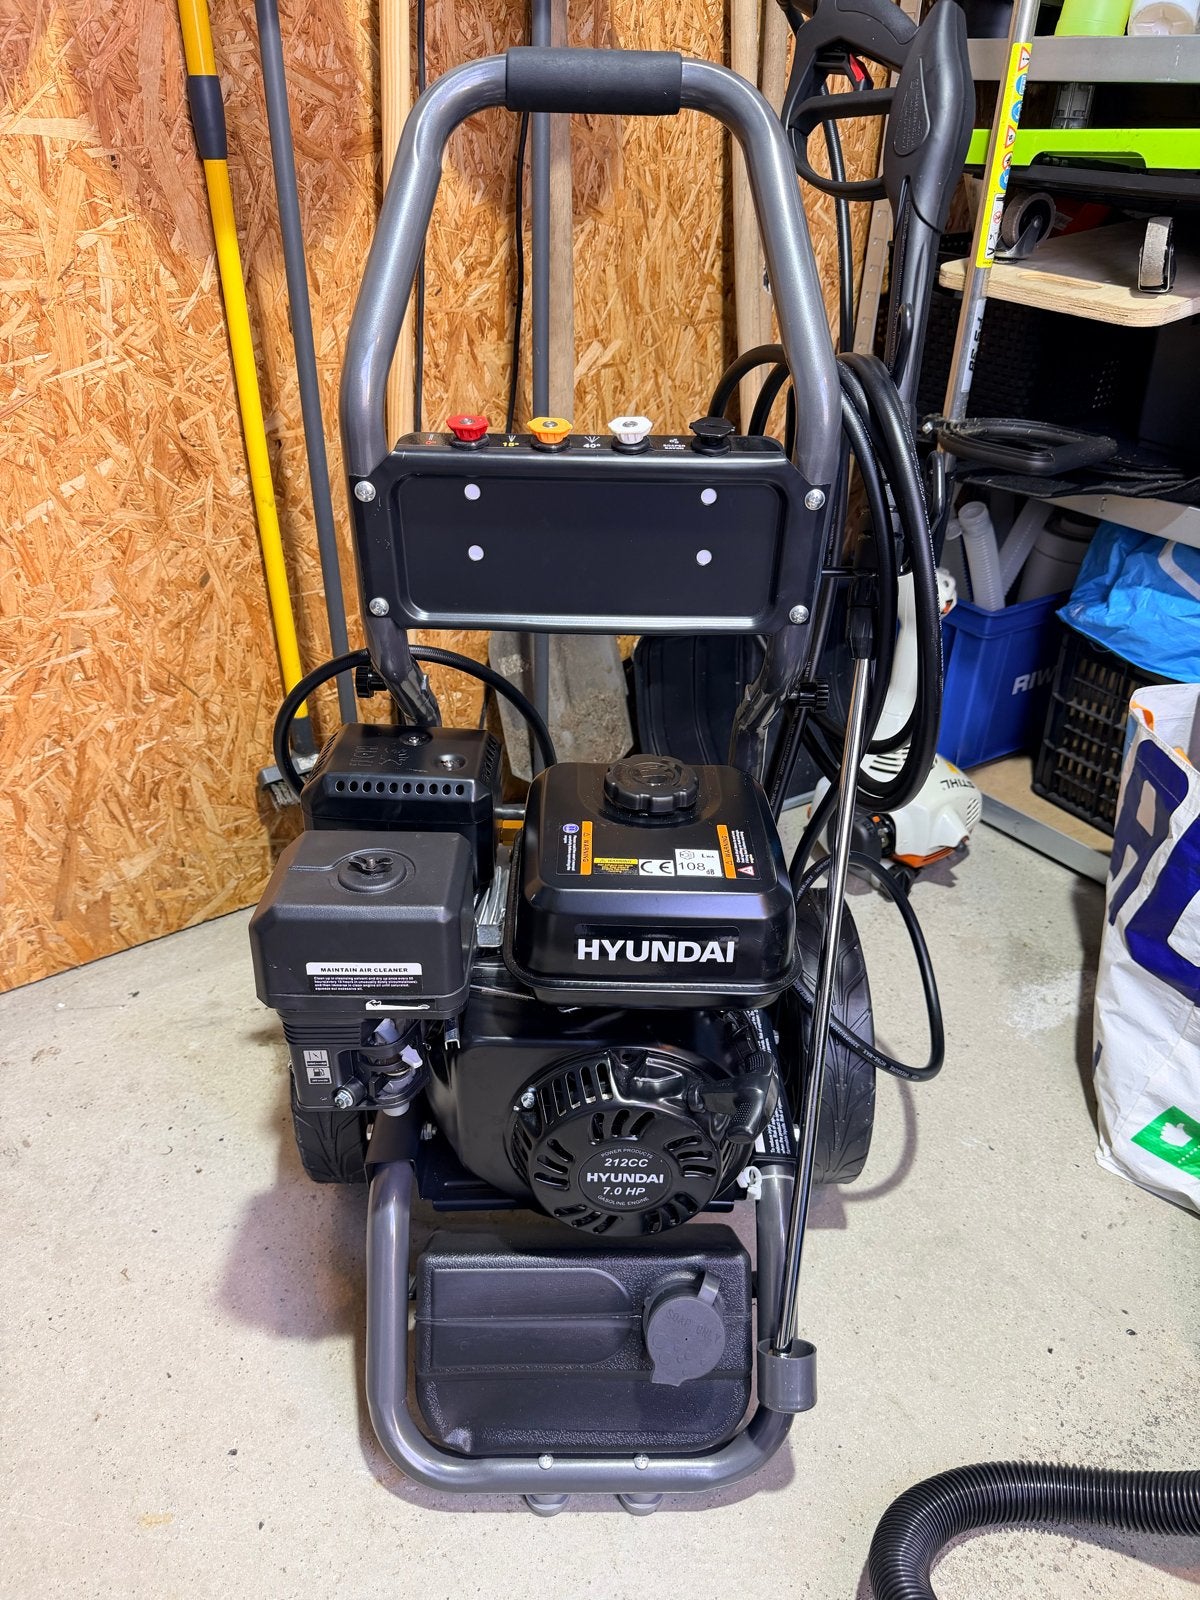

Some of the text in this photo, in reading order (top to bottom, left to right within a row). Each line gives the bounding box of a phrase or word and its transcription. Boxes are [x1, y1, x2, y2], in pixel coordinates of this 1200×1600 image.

[940, 778, 976, 790] STIHL
[678, 862, 706, 872] 108
[577, 938, 735, 963] HYUNDAI
[601, 1148, 654, 1159] POWER PRODUCTS
[604, 1158, 649, 1168] 212CC
[586, 1172, 664, 1184] HYUNDAI
[603, 1186, 646, 1196] 7.0 HP
[597, 1194, 650, 1206] GASOLINE ENGINE
